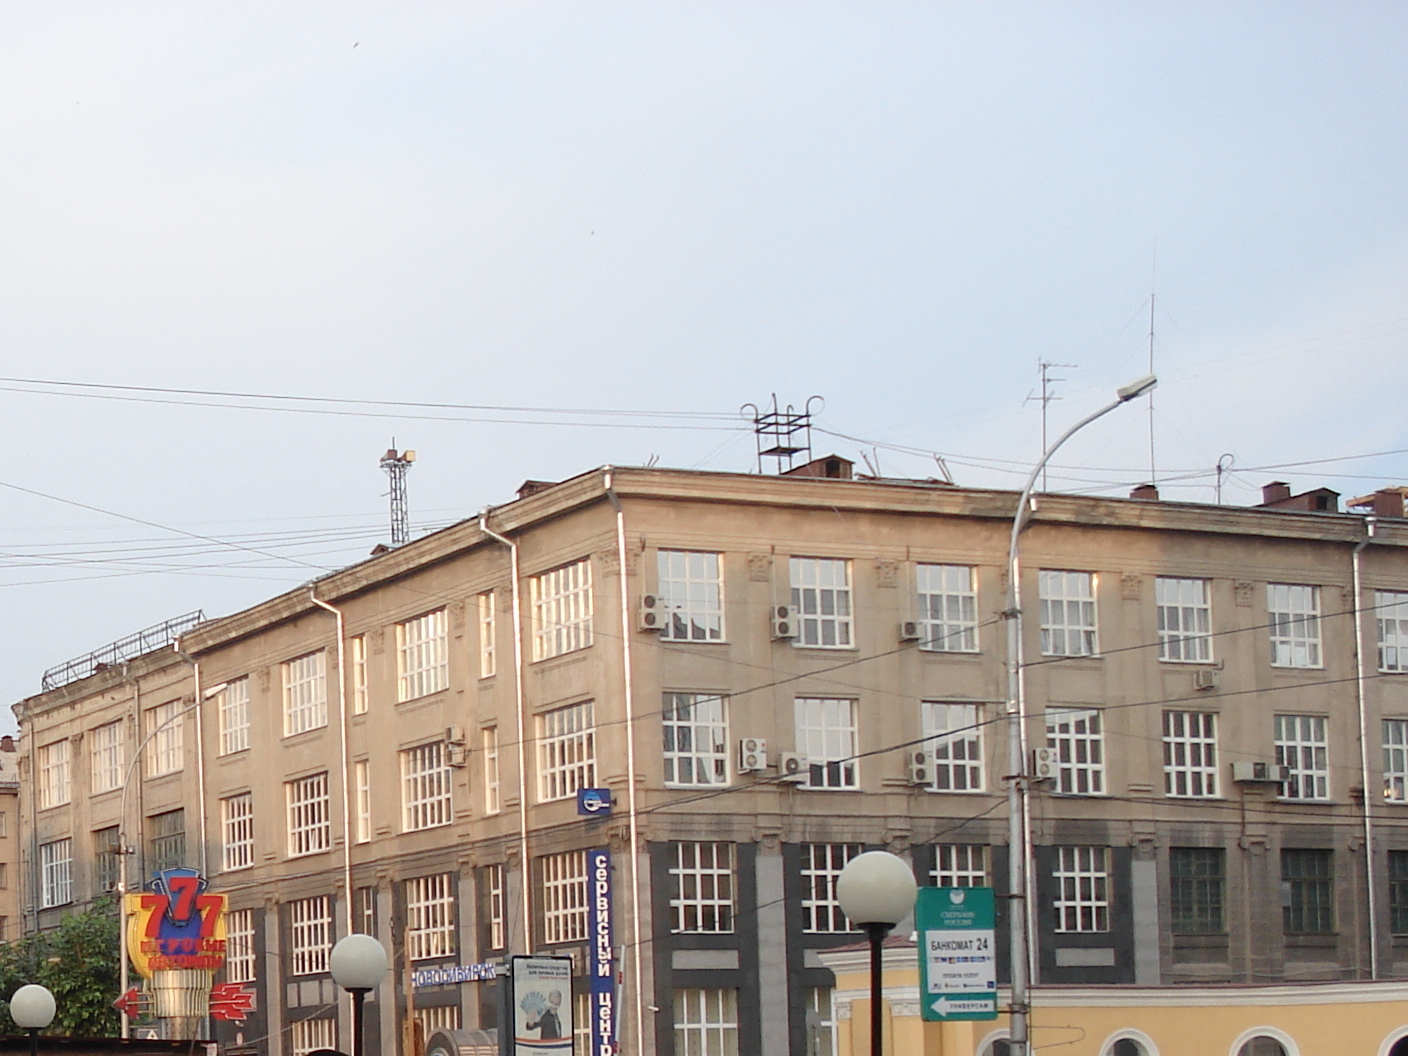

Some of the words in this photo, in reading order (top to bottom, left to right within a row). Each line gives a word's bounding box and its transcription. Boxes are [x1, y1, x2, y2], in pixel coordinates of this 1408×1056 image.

[595, 855, 612, 977] сервисный
[931, 940, 974, 952] БАНКОМАТ
[976, 937, 989, 951] 24
